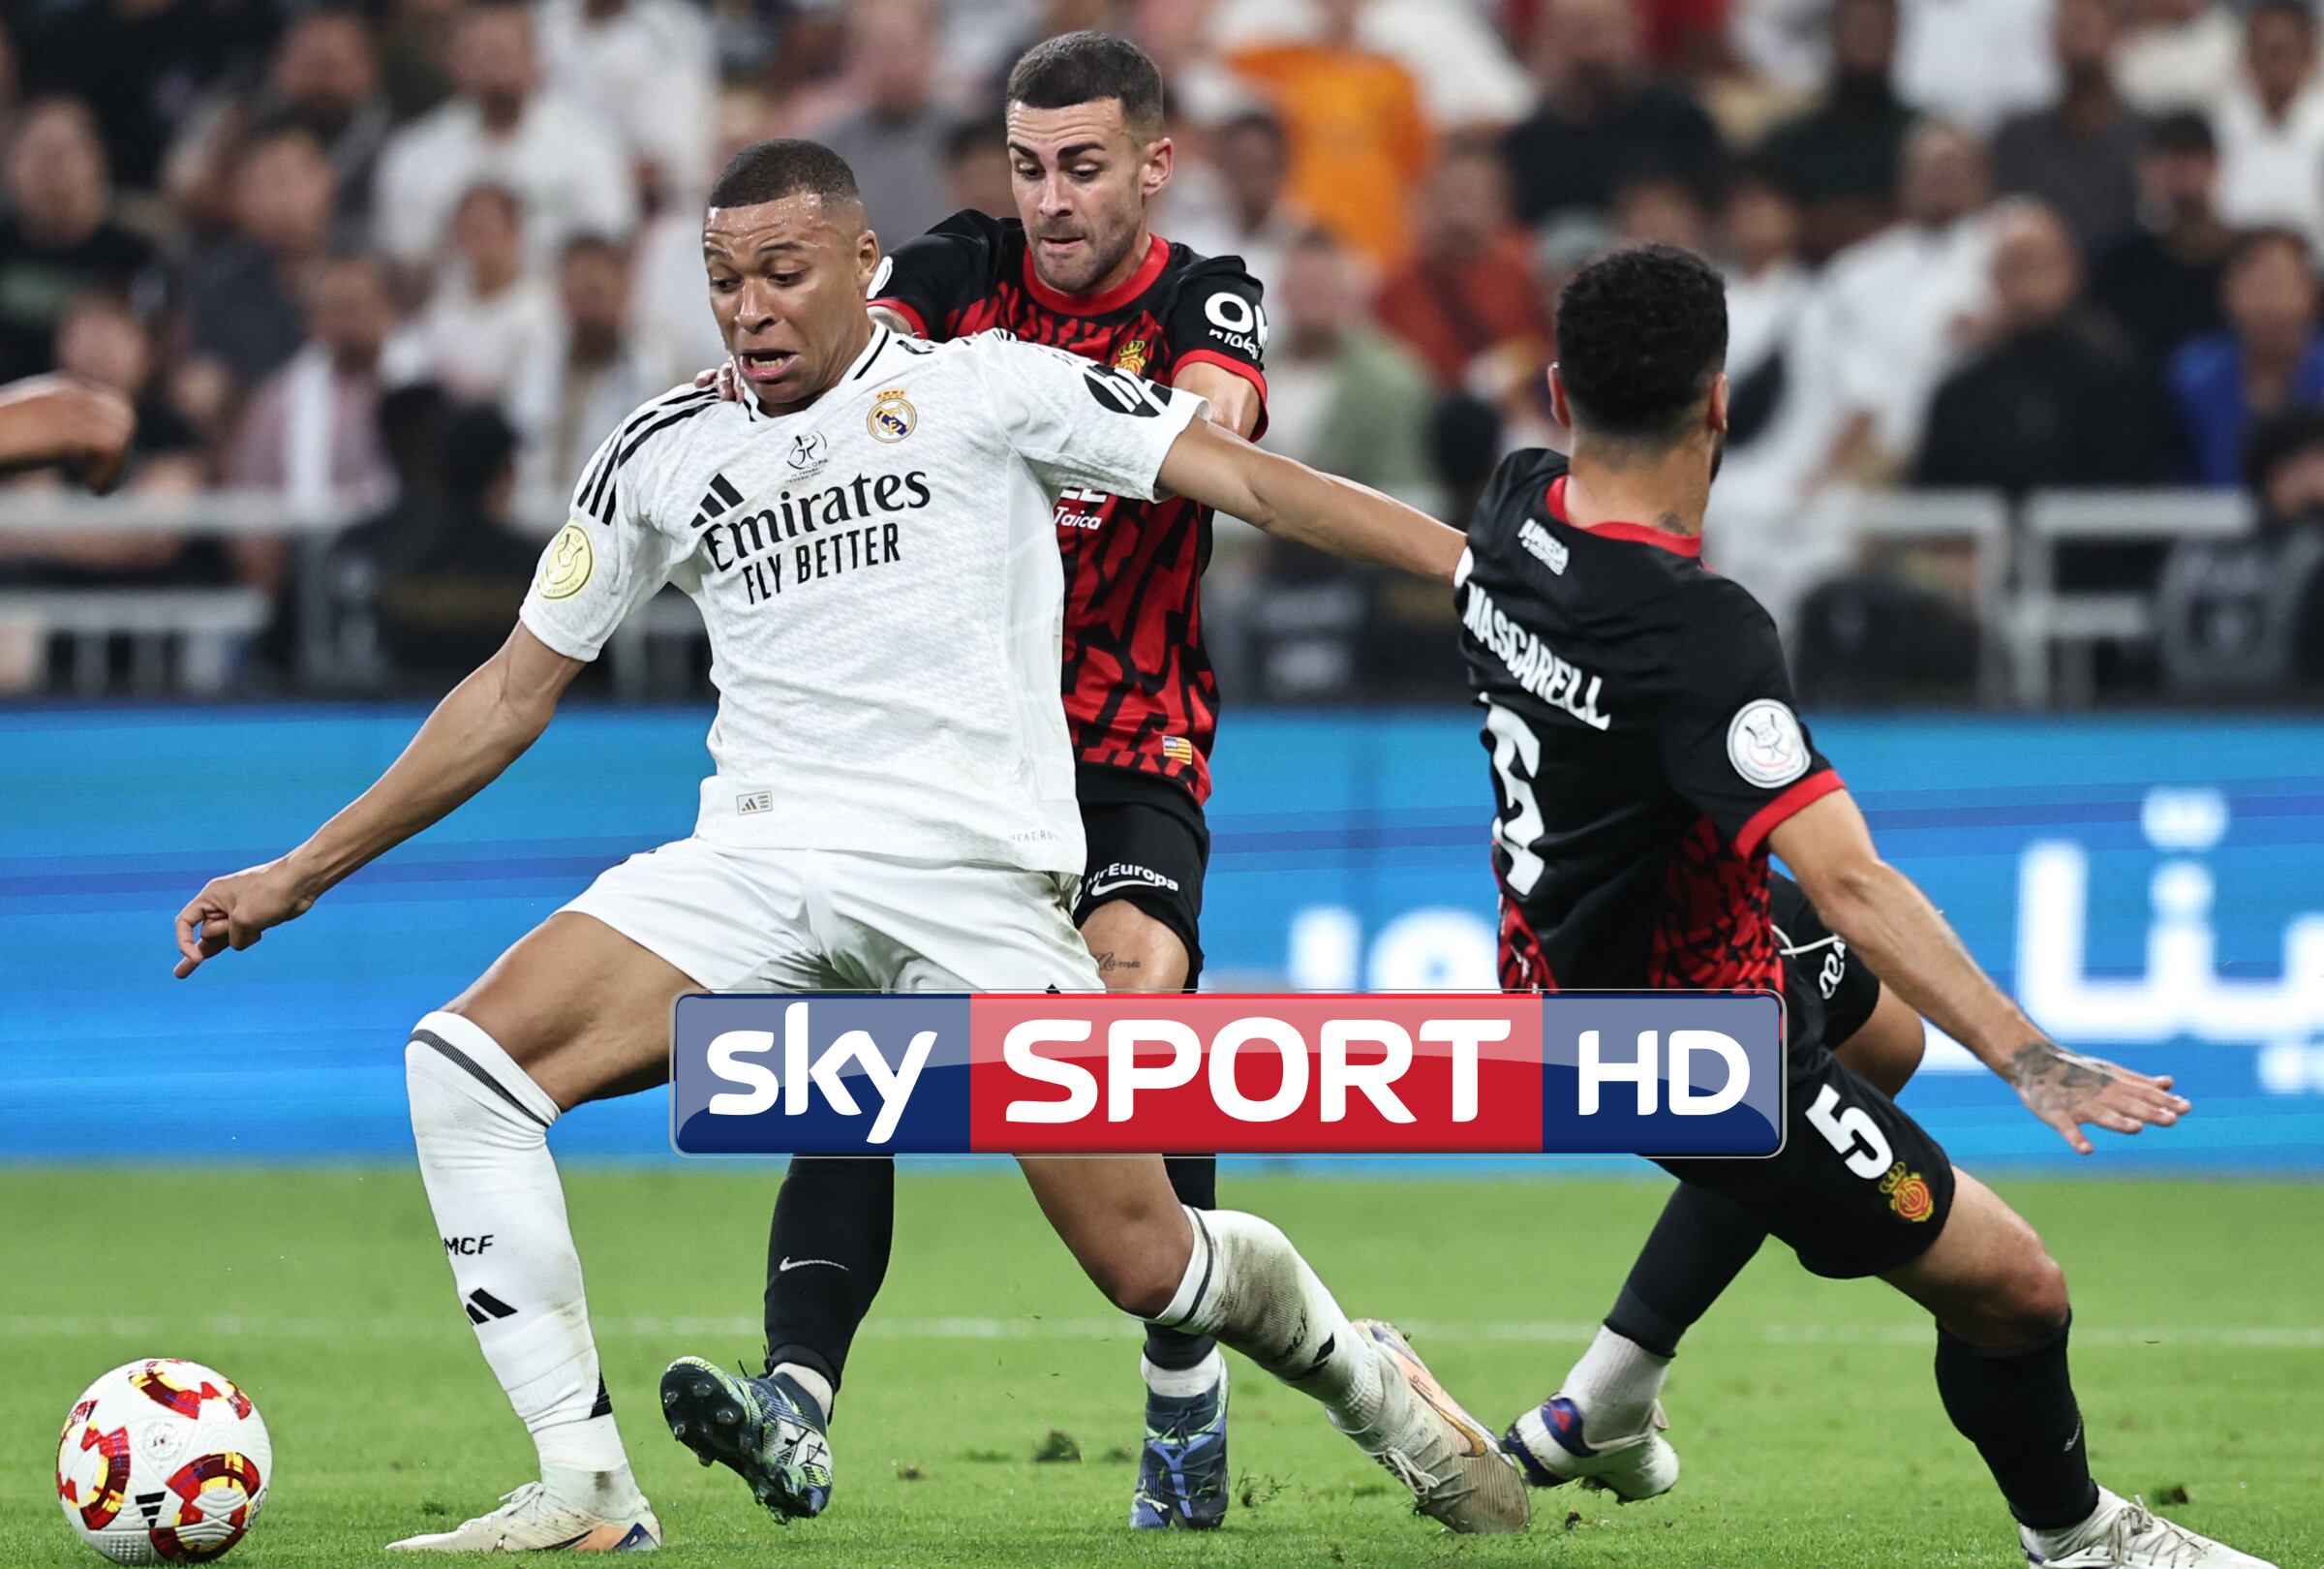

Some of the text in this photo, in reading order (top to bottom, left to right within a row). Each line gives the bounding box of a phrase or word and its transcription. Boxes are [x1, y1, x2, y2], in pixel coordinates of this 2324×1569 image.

[703, 471, 931, 572] Emirates
[743, 522, 902, 604] FLY BETTER
[1054, 506, 1102, 530] Taica
[1463, 580, 1611, 731] MASCARELL
[1805, 1083, 1893, 1179] 5
